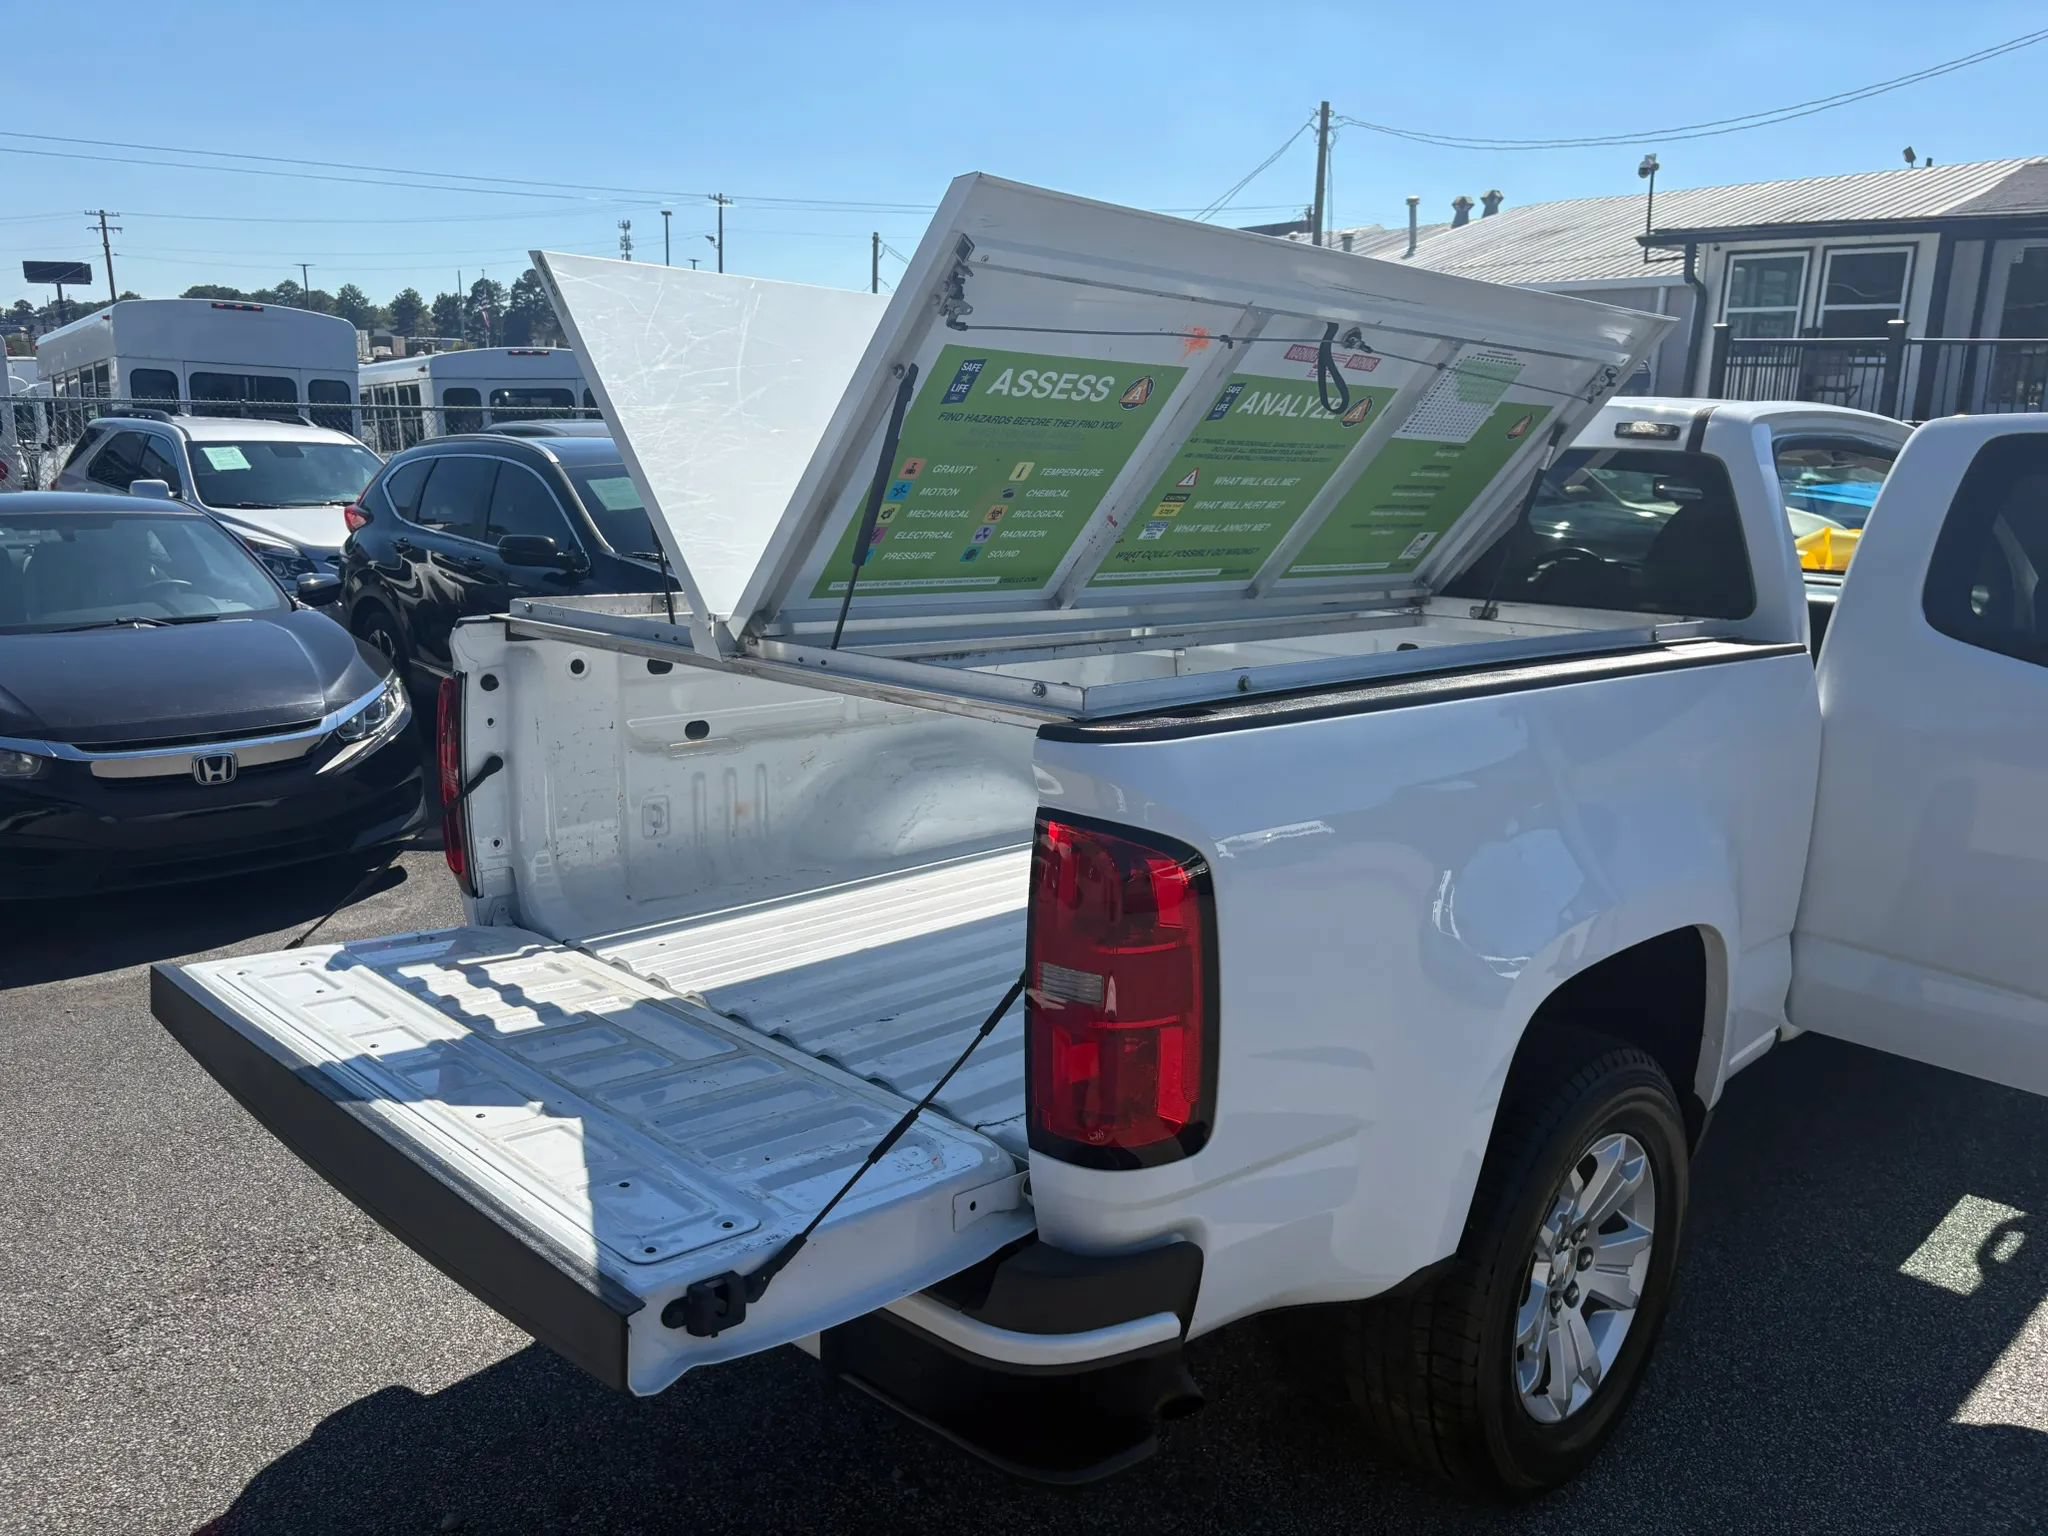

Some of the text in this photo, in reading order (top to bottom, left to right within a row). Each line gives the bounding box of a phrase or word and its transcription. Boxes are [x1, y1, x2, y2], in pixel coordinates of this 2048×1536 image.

[961, 362, 982, 372] SAFE
[951, 383, 970, 393] LIFE
[986, 368, 1115, 402] ASSESS
[1226, 386, 1243, 394] SAFE
[1215, 403, 1229, 412] LIFE
[938, 411, 962, 423] FIND
[964, 413, 1011, 425] HAZARDS
[1012, 416, 1051, 427] BEFORE
[1053, 418, 1078, 429] THEY
[1077, 420, 1100, 430] FIND
[932, 464, 978, 475] GRAVITY
[1039, 467, 1104, 477] TEMPERATURE
[1213, 476, 1241, 486] WHAT
[1240, 476, 1261, 486] WILL
[919, 487, 960, 497] MOTION
[1025, 488, 1071, 498] CHEMICAL
[1193, 500, 1221, 510] WHAT
[1220, 500, 1242, 510] WILL
[906, 508, 971, 519] MECHANICAL
[1012, 509, 1065, 519] BIOLOGICAL
[1174, 523, 1201, 533] WHAT
[894, 530, 954, 540] ELECTRICAL
[1000, 529, 1048, 539] RADIATION
[882, 550, 937, 561] PRESSURE
[987, 549, 1021, 559] SOUND
